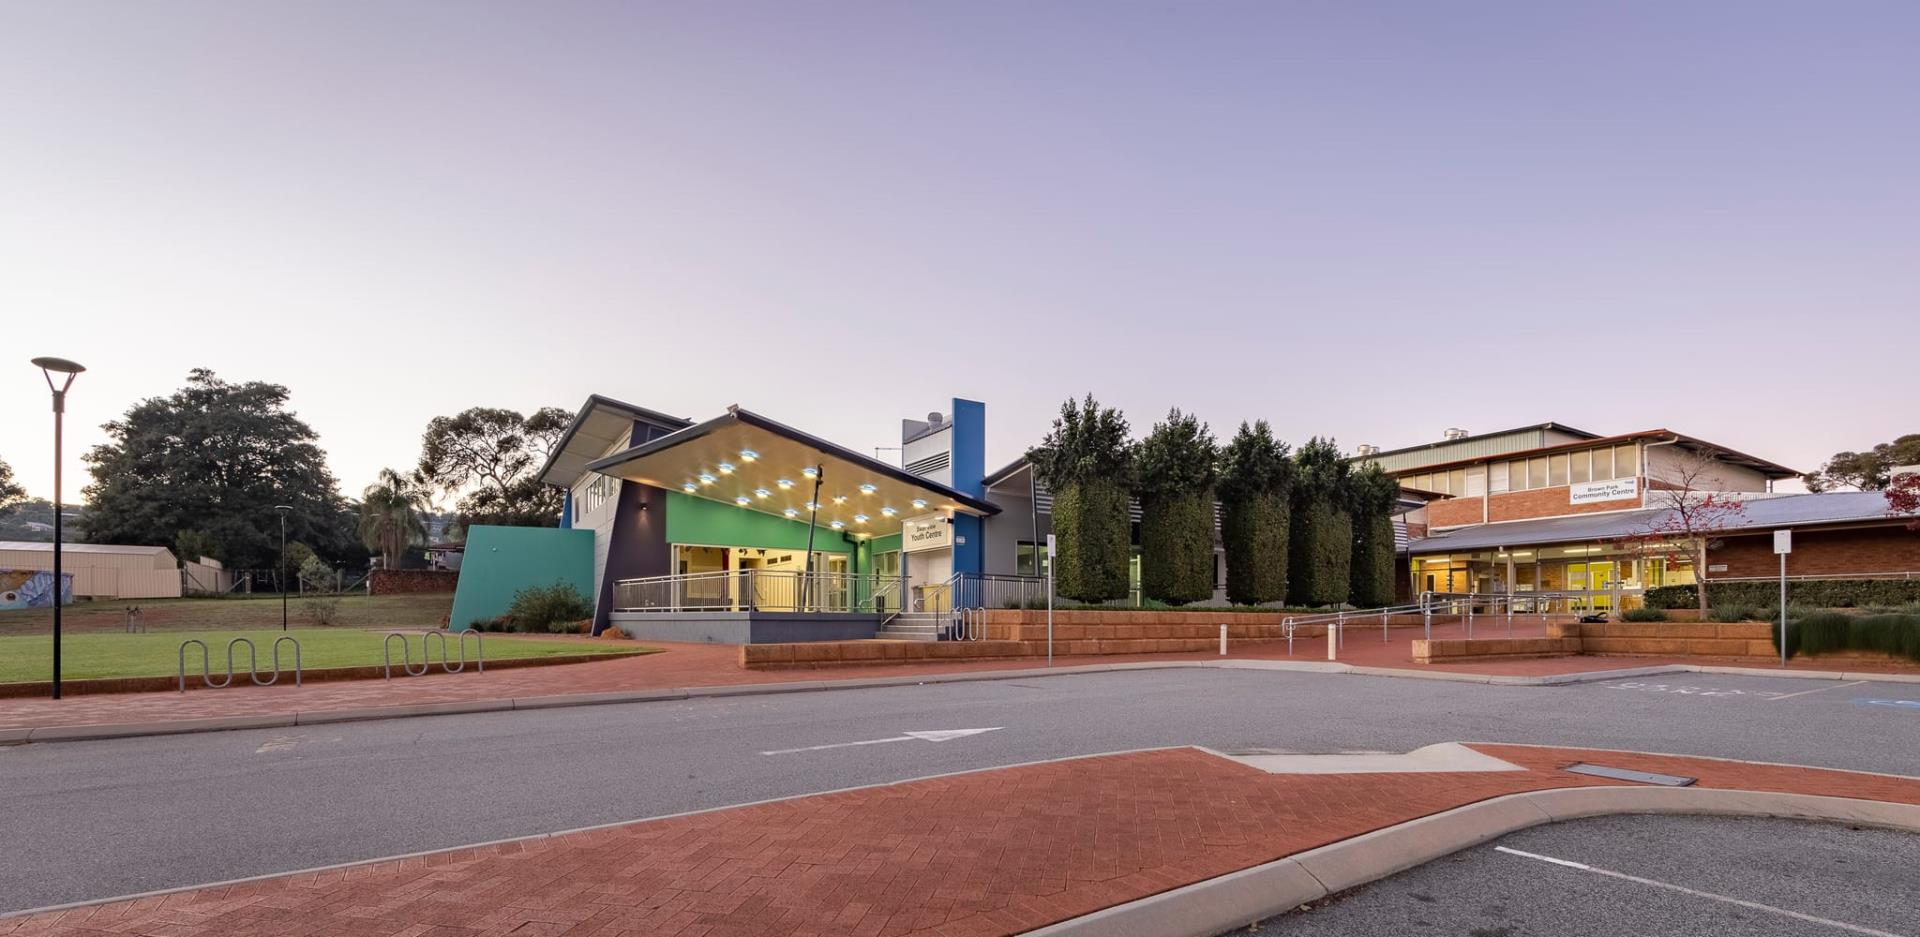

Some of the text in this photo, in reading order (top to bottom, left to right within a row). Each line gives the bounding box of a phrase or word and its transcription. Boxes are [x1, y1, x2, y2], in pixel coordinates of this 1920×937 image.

[1573, 488, 1635, 499] Community Centre
[911, 530, 942, 541] Youth Centre
